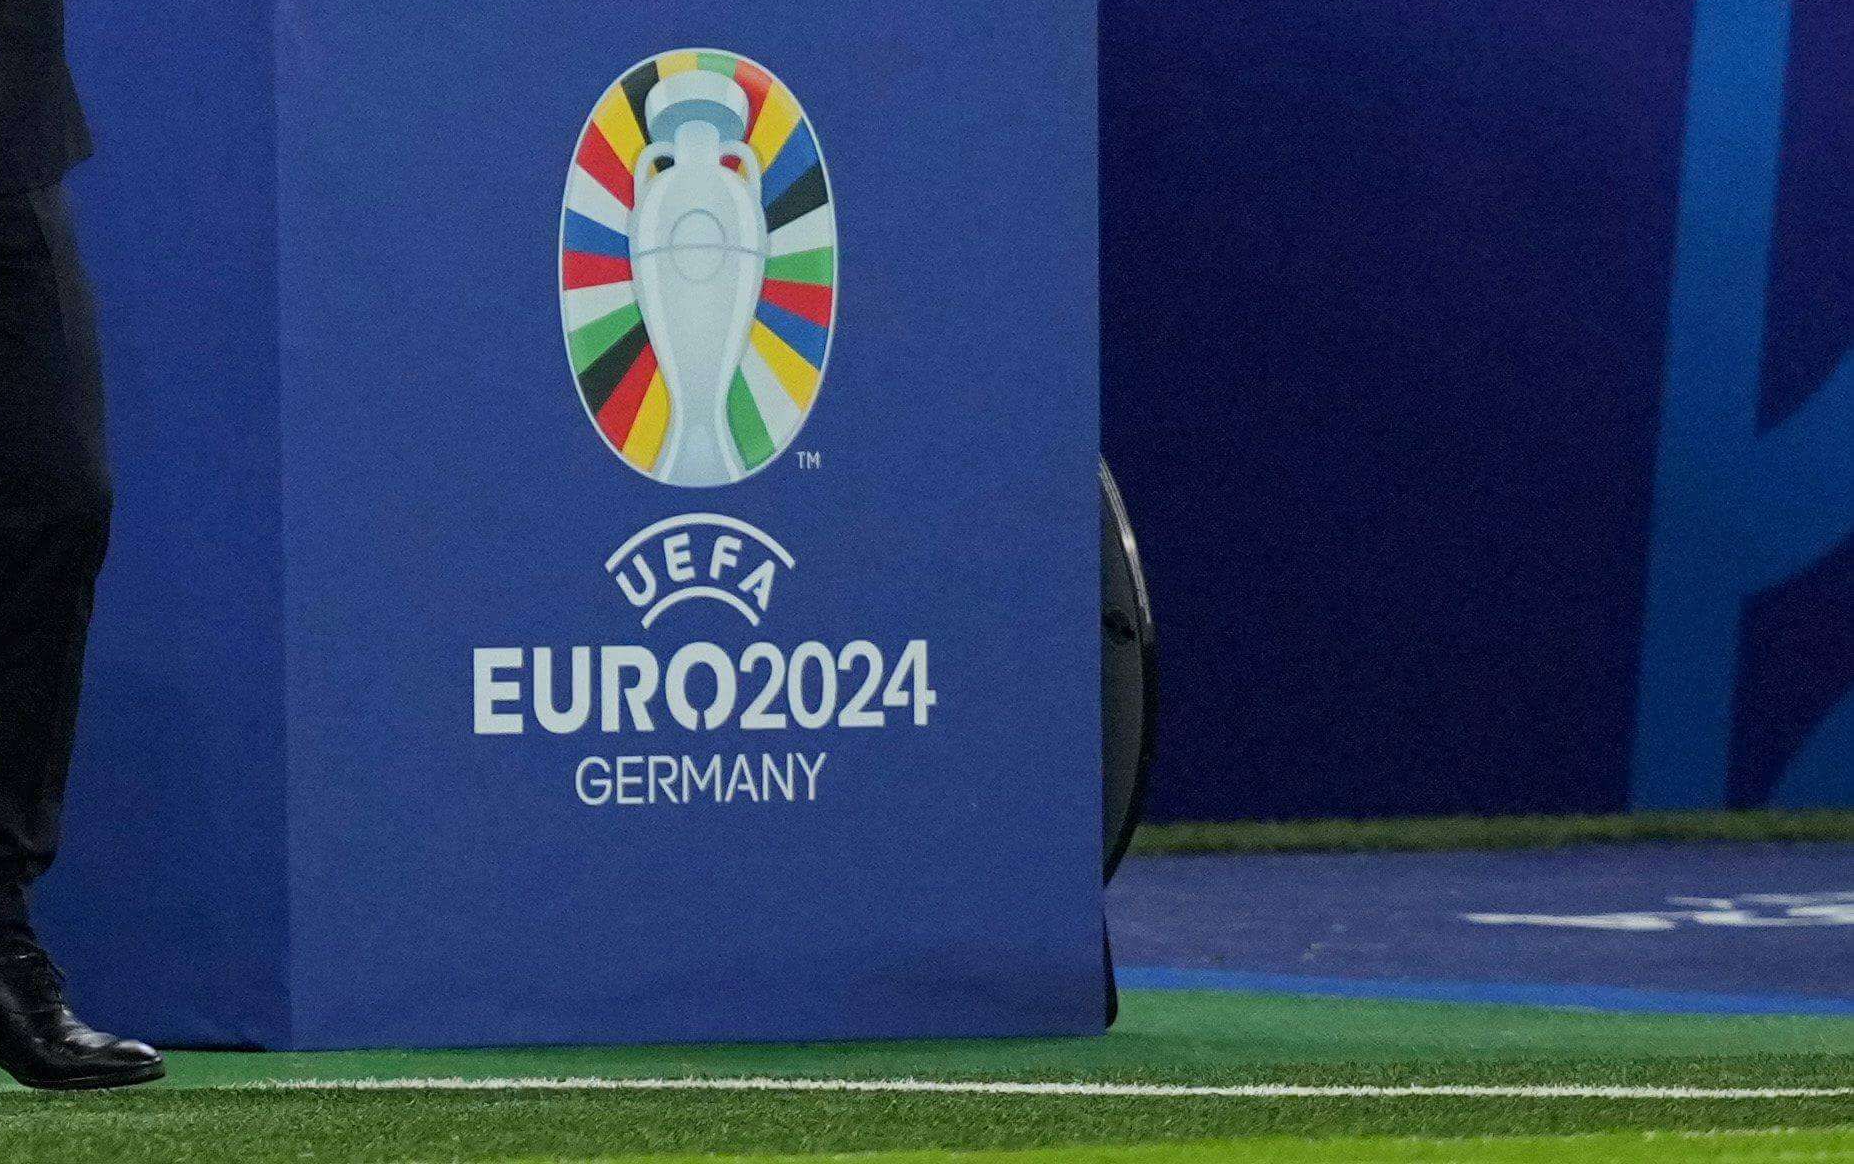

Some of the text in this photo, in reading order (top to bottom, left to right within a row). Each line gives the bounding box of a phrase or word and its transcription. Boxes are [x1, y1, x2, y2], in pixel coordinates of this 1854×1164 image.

[796, 450, 822, 470] TM
[616, 532, 775, 612] UEFA
[473, 639, 937, 734] EURO2024
[575, 752, 827, 807] GERMANY
